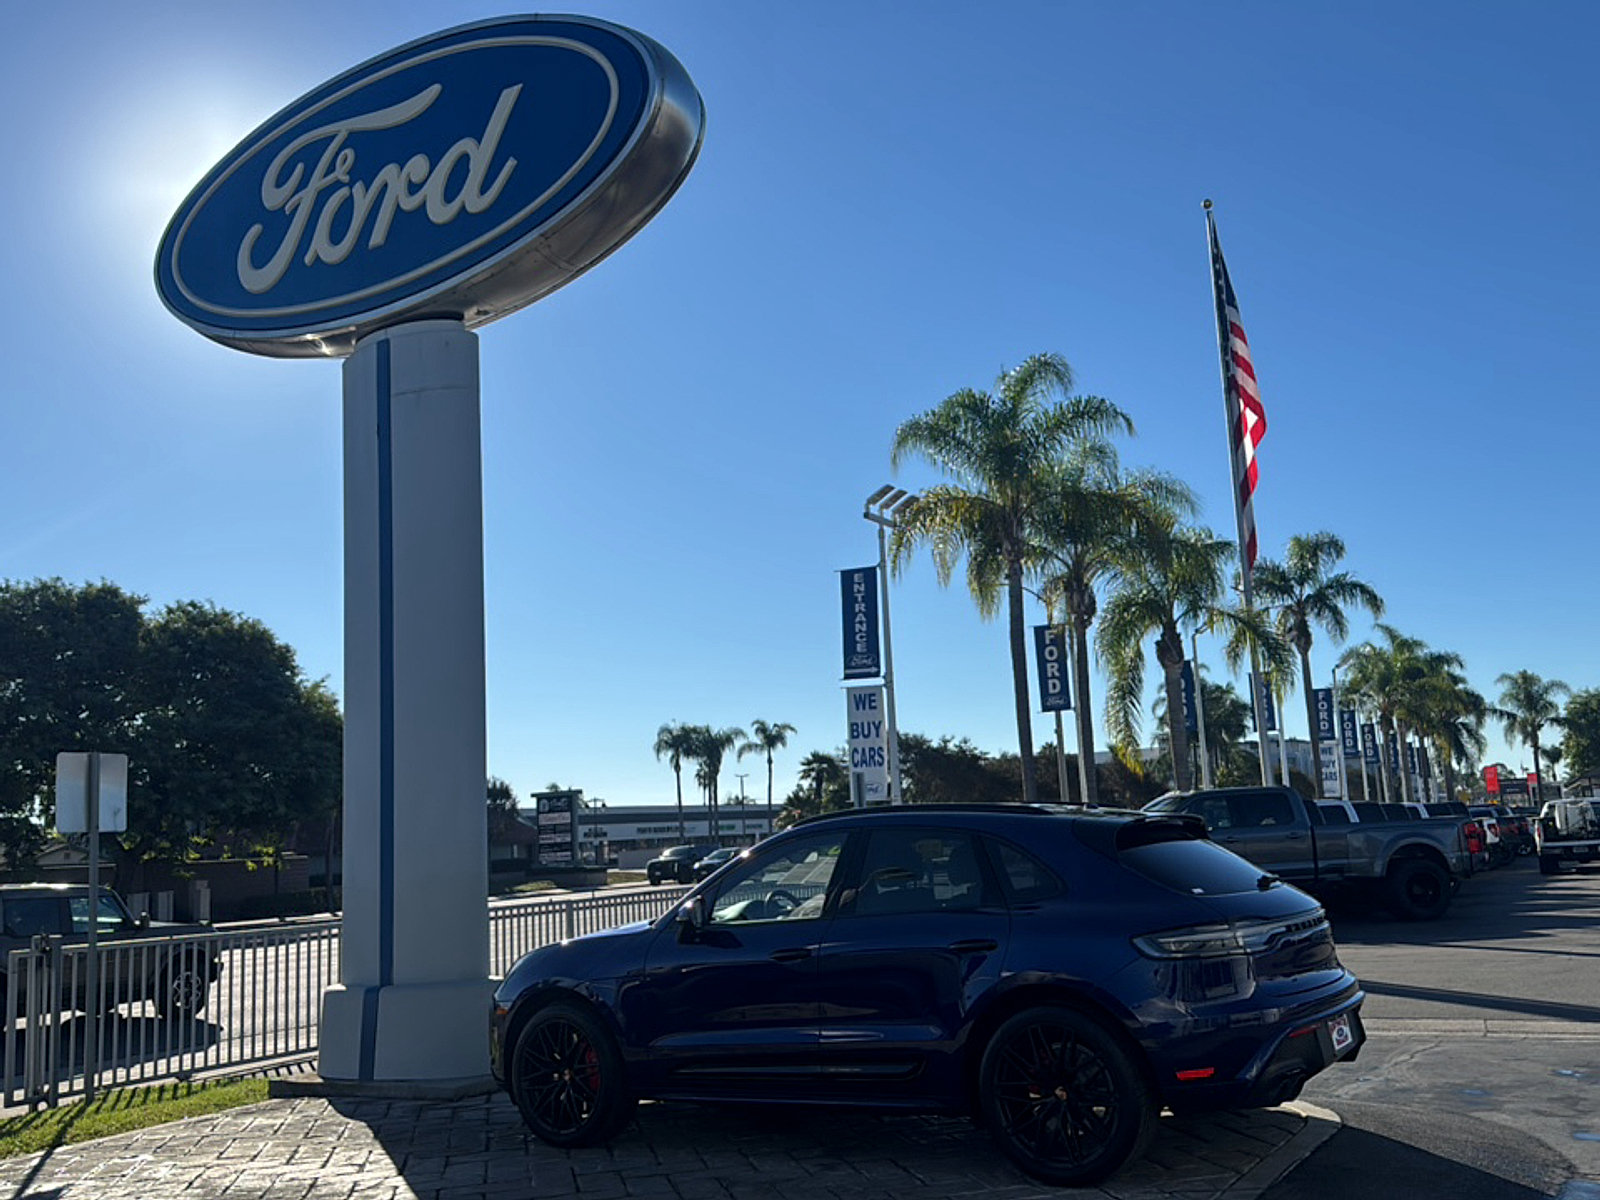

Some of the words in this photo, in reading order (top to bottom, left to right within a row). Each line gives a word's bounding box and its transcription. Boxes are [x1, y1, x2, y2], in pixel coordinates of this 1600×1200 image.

[237, 83, 523, 294] Ford
[853, 573, 867, 652] ENTRANCE
[1044, 630, 1061, 694] FORD
[853, 693, 877, 711] WE
[1318, 691, 1329, 730] FORD
[850, 721, 882, 739] BUY
[1343, 713, 1353, 746] FORD
[851, 746, 885, 768] CARS
